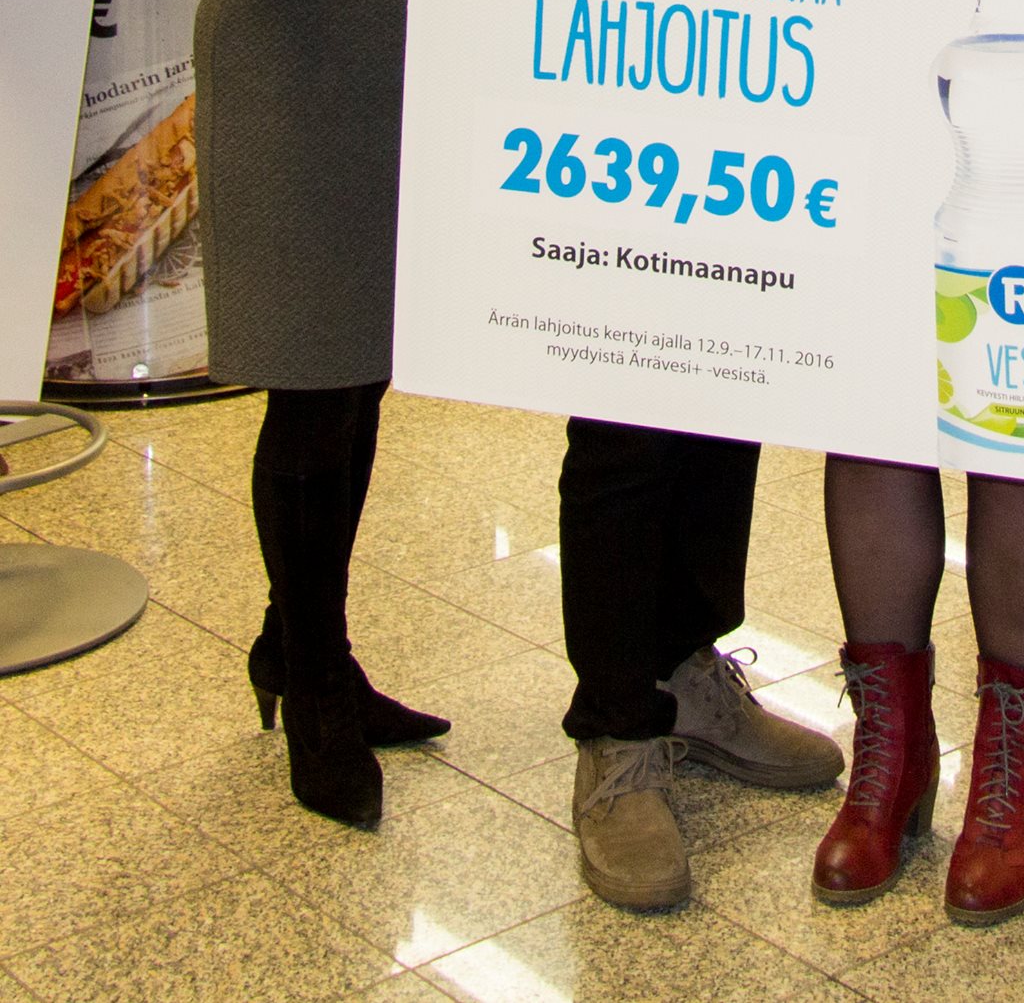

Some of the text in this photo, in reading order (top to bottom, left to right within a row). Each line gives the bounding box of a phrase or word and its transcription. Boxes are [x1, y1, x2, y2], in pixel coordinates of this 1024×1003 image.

[84, 72, 161, 108] hodarin
[499, 127, 839, 228] 2639,50 €
[532, 237, 796, 292] Saaja: Kotimaanapu
[488, 310, 529, 331] Ärrän
[533, 316, 600, 339] lahjoitus
[604, 324, 648, 347] kertyi
[652, 330, 693, 351] ajalla
[795, 351, 835, 371] 2016
[546, 341, 771, 386] myydyistä Ärrävesi+ -vesistä.
[976, 388, 1008, 401] KEVYESTI
